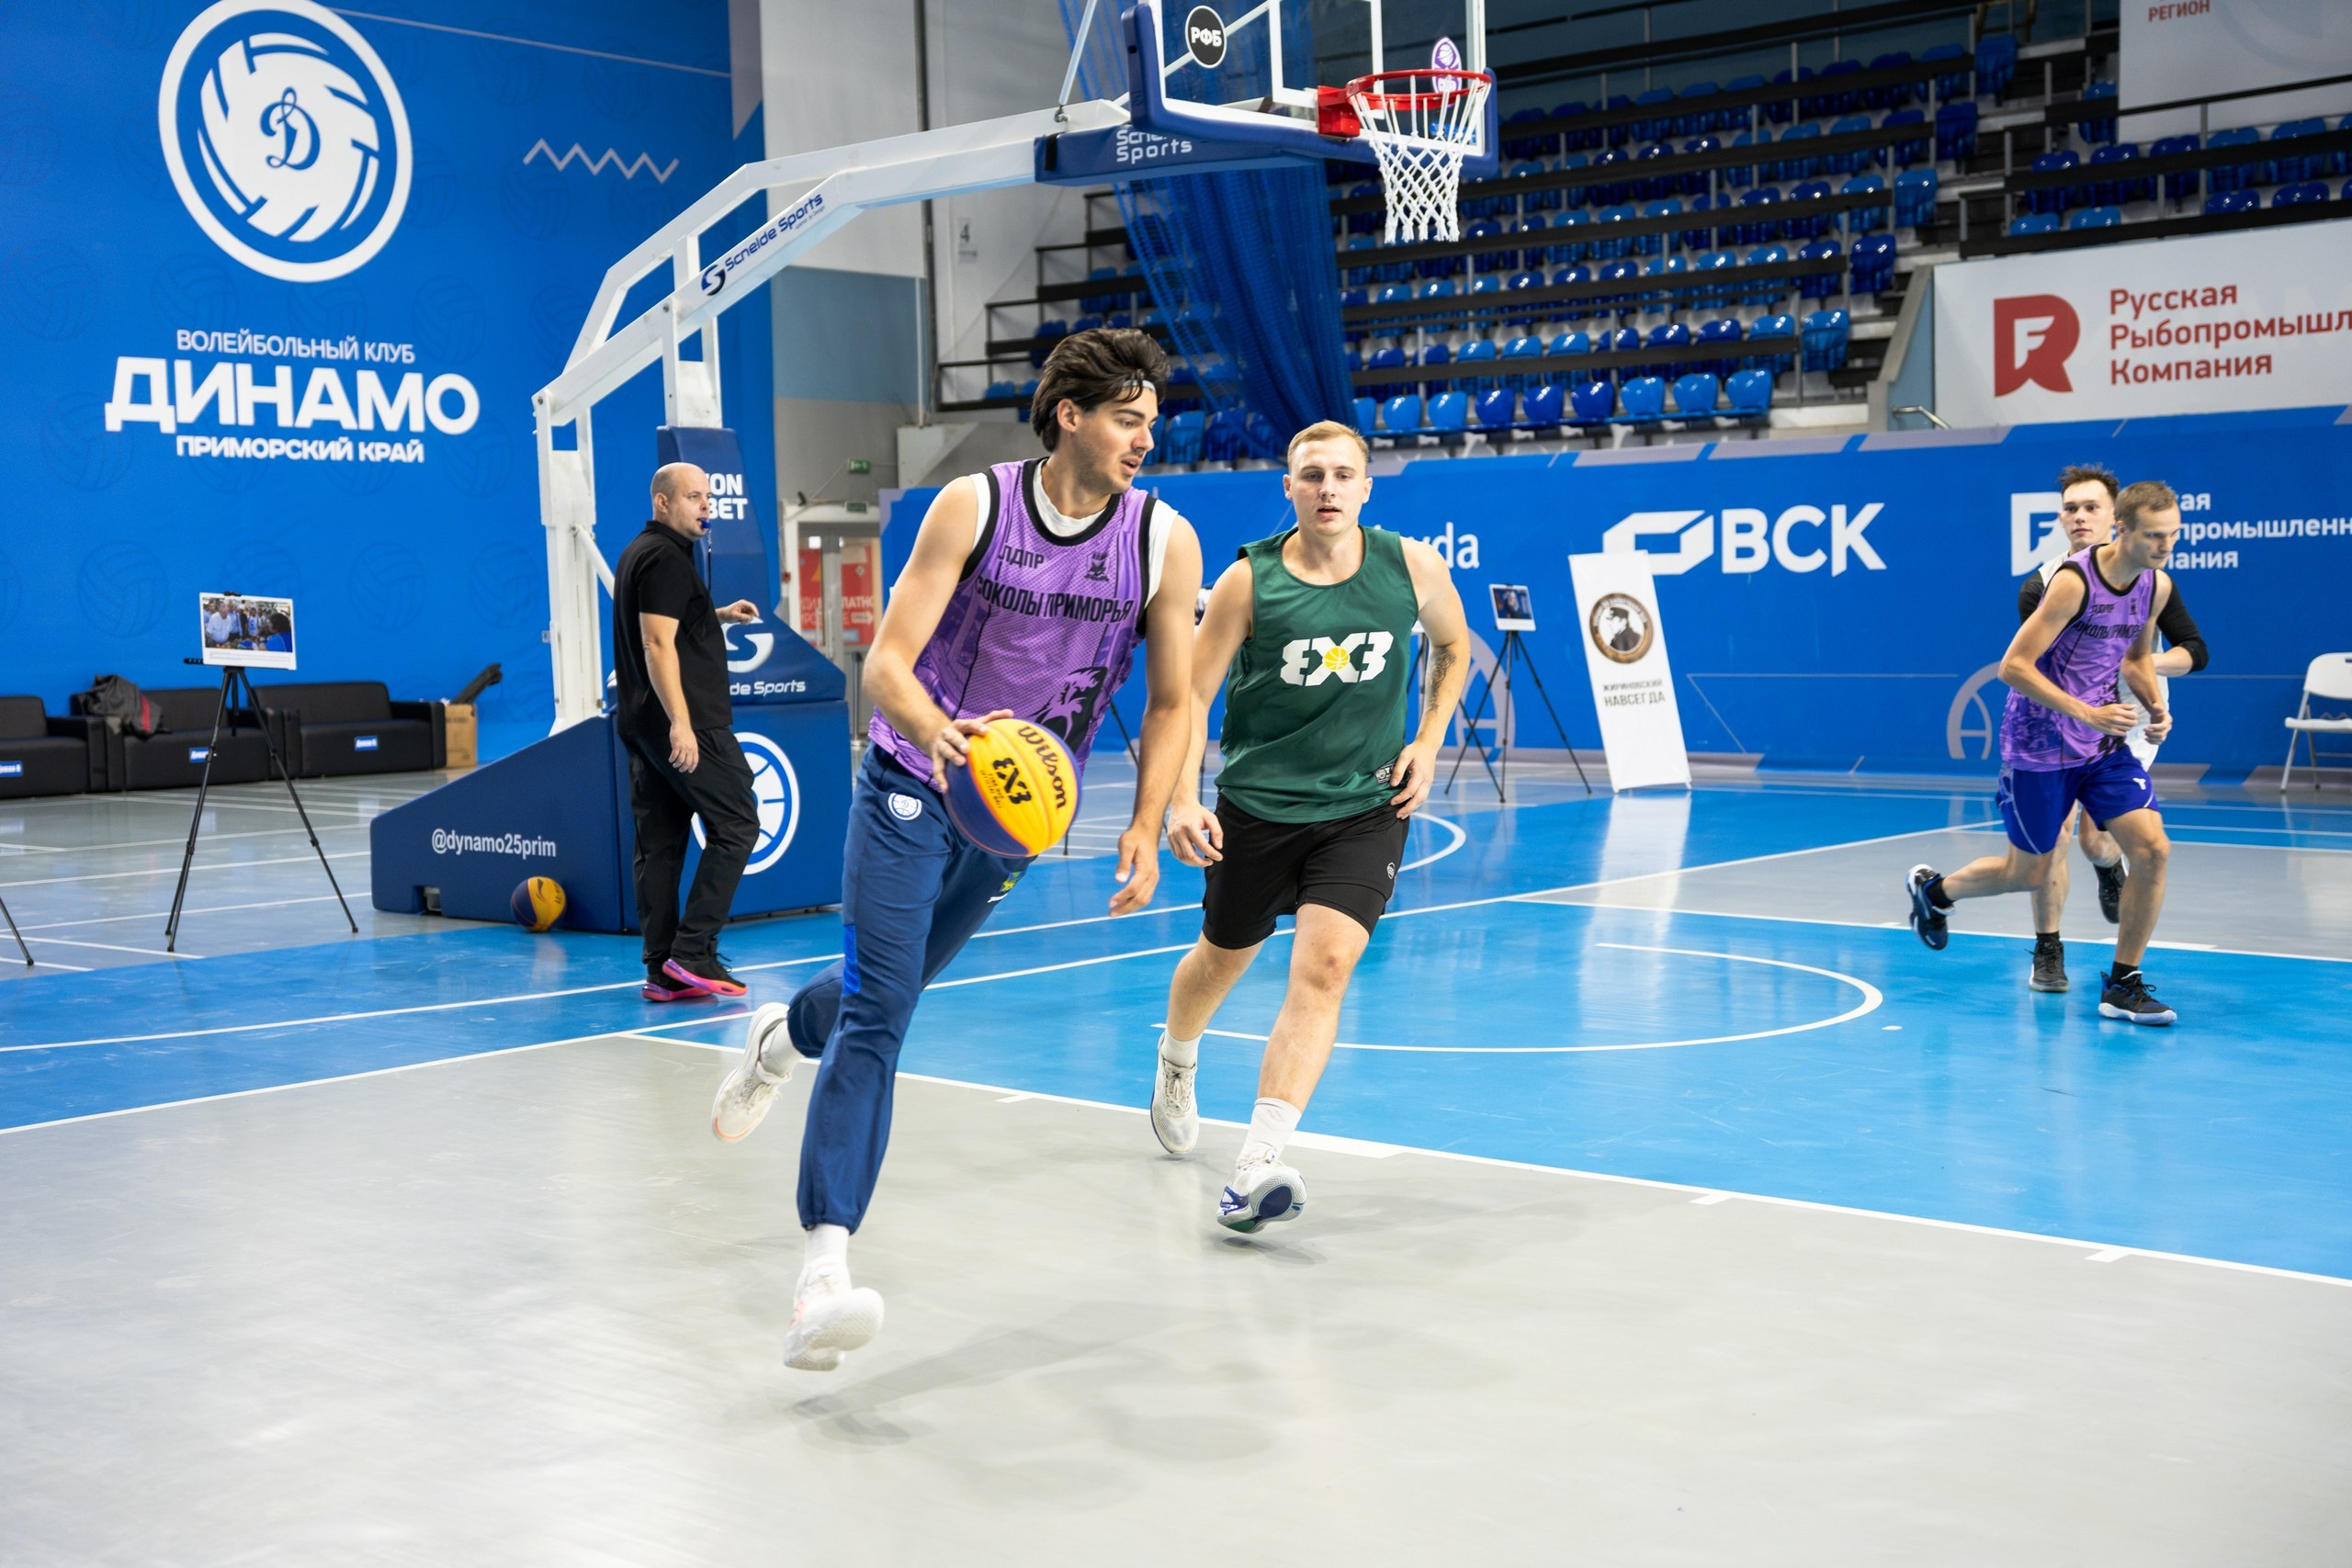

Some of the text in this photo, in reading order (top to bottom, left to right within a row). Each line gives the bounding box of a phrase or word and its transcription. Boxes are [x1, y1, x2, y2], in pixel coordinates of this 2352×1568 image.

[2147, 0, 2211, 22] РЕГИОН
[1190, 26, 1223, 47] РФБ
[1116, 139, 1193, 164] Sports
[777, 193, 824, 231] Sports
[2110, 285, 2238, 321] Русская
[2110, 310, 2352, 351] Рыбопромышл
[177, 328, 416, 365] ВОЛЕЙБОЛЬНЫЙ КЛУБ
[2110, 354, 2273, 386] Компания
[105, 355, 481, 435] ДИНАМО
[176, 435, 425, 464] ПРИМОРСКИЙ КРАЙ
[706, 472, 743, 496] ON
[707, 497, 749, 520] BET
[1721, 502, 1888, 578] ВСК
[2177, 516, 2352, 547] промышленн
[997, 545, 1045, 570] ЛДПР
[2165, 550, 2239, 570] ания
[753, 679, 807, 697] Sports
[1017, 726, 1068, 810] Wilson
[431, 828, 557, 861] @dynamo25prim
